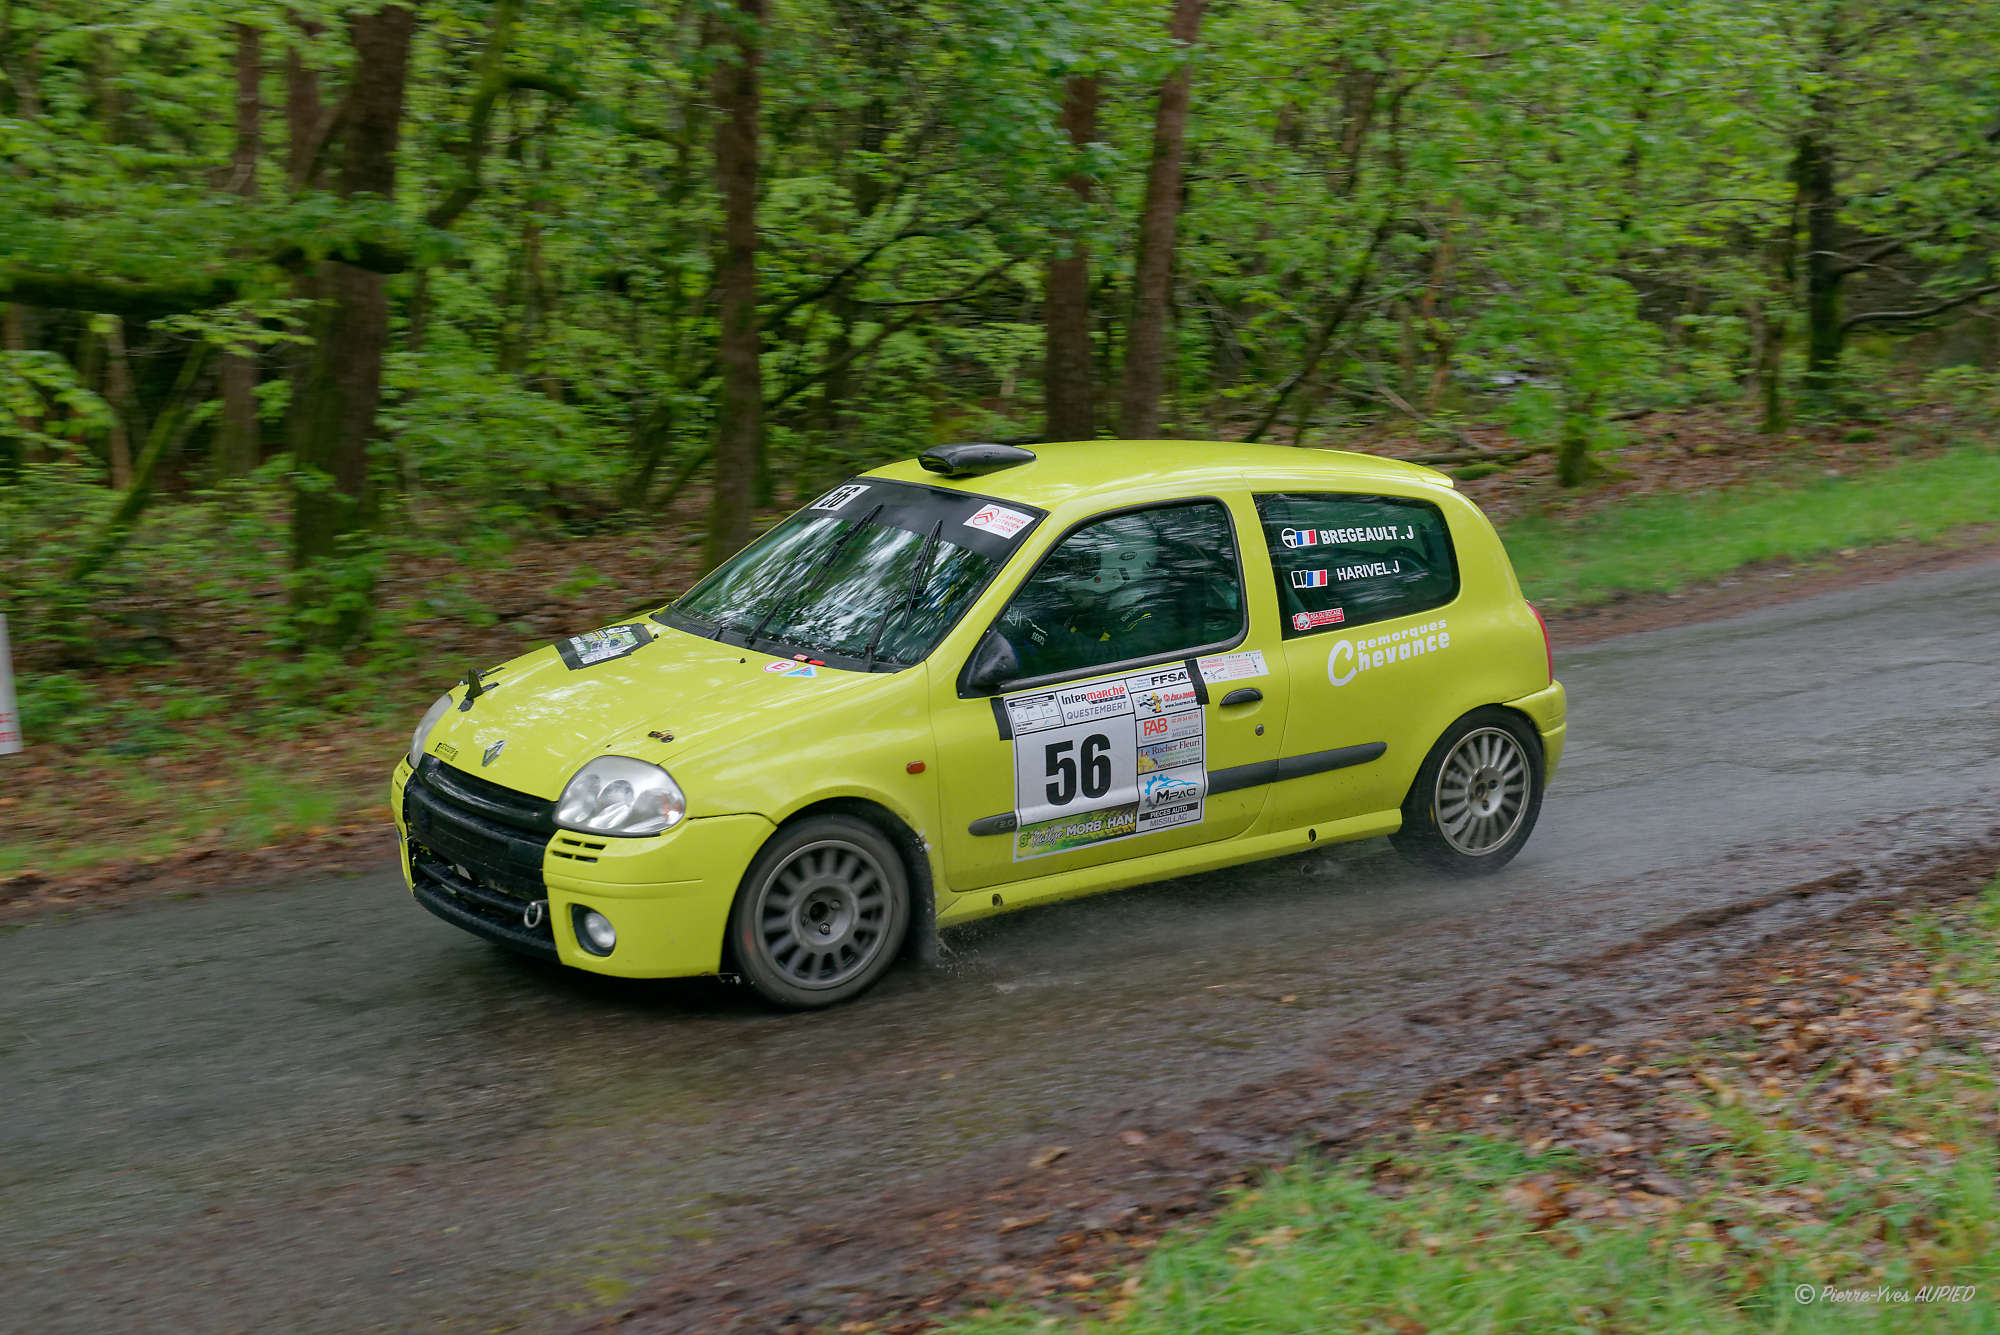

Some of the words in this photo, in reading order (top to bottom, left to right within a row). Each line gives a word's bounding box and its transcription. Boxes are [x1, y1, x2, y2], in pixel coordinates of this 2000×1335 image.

[819, 486, 861, 508] 56
[1336, 562, 1392, 581] HARIVEL
[1392, 560, 1400, 573] J
[1357, 619, 1447, 651] Remorques
[1328, 631, 1450, 686] Chevance
[1151, 671, 1187, 686] FFSA
[1066, 701, 1128, 720] QUESTEMBERT
[1144, 717, 1168, 736] FAB
[1179, 738, 1201, 750] Fleuri
[1045, 733, 1112, 806] 56
[1171, 805, 1188, 815] AUTO
[1150, 813, 1188, 827] MISSILLAC
